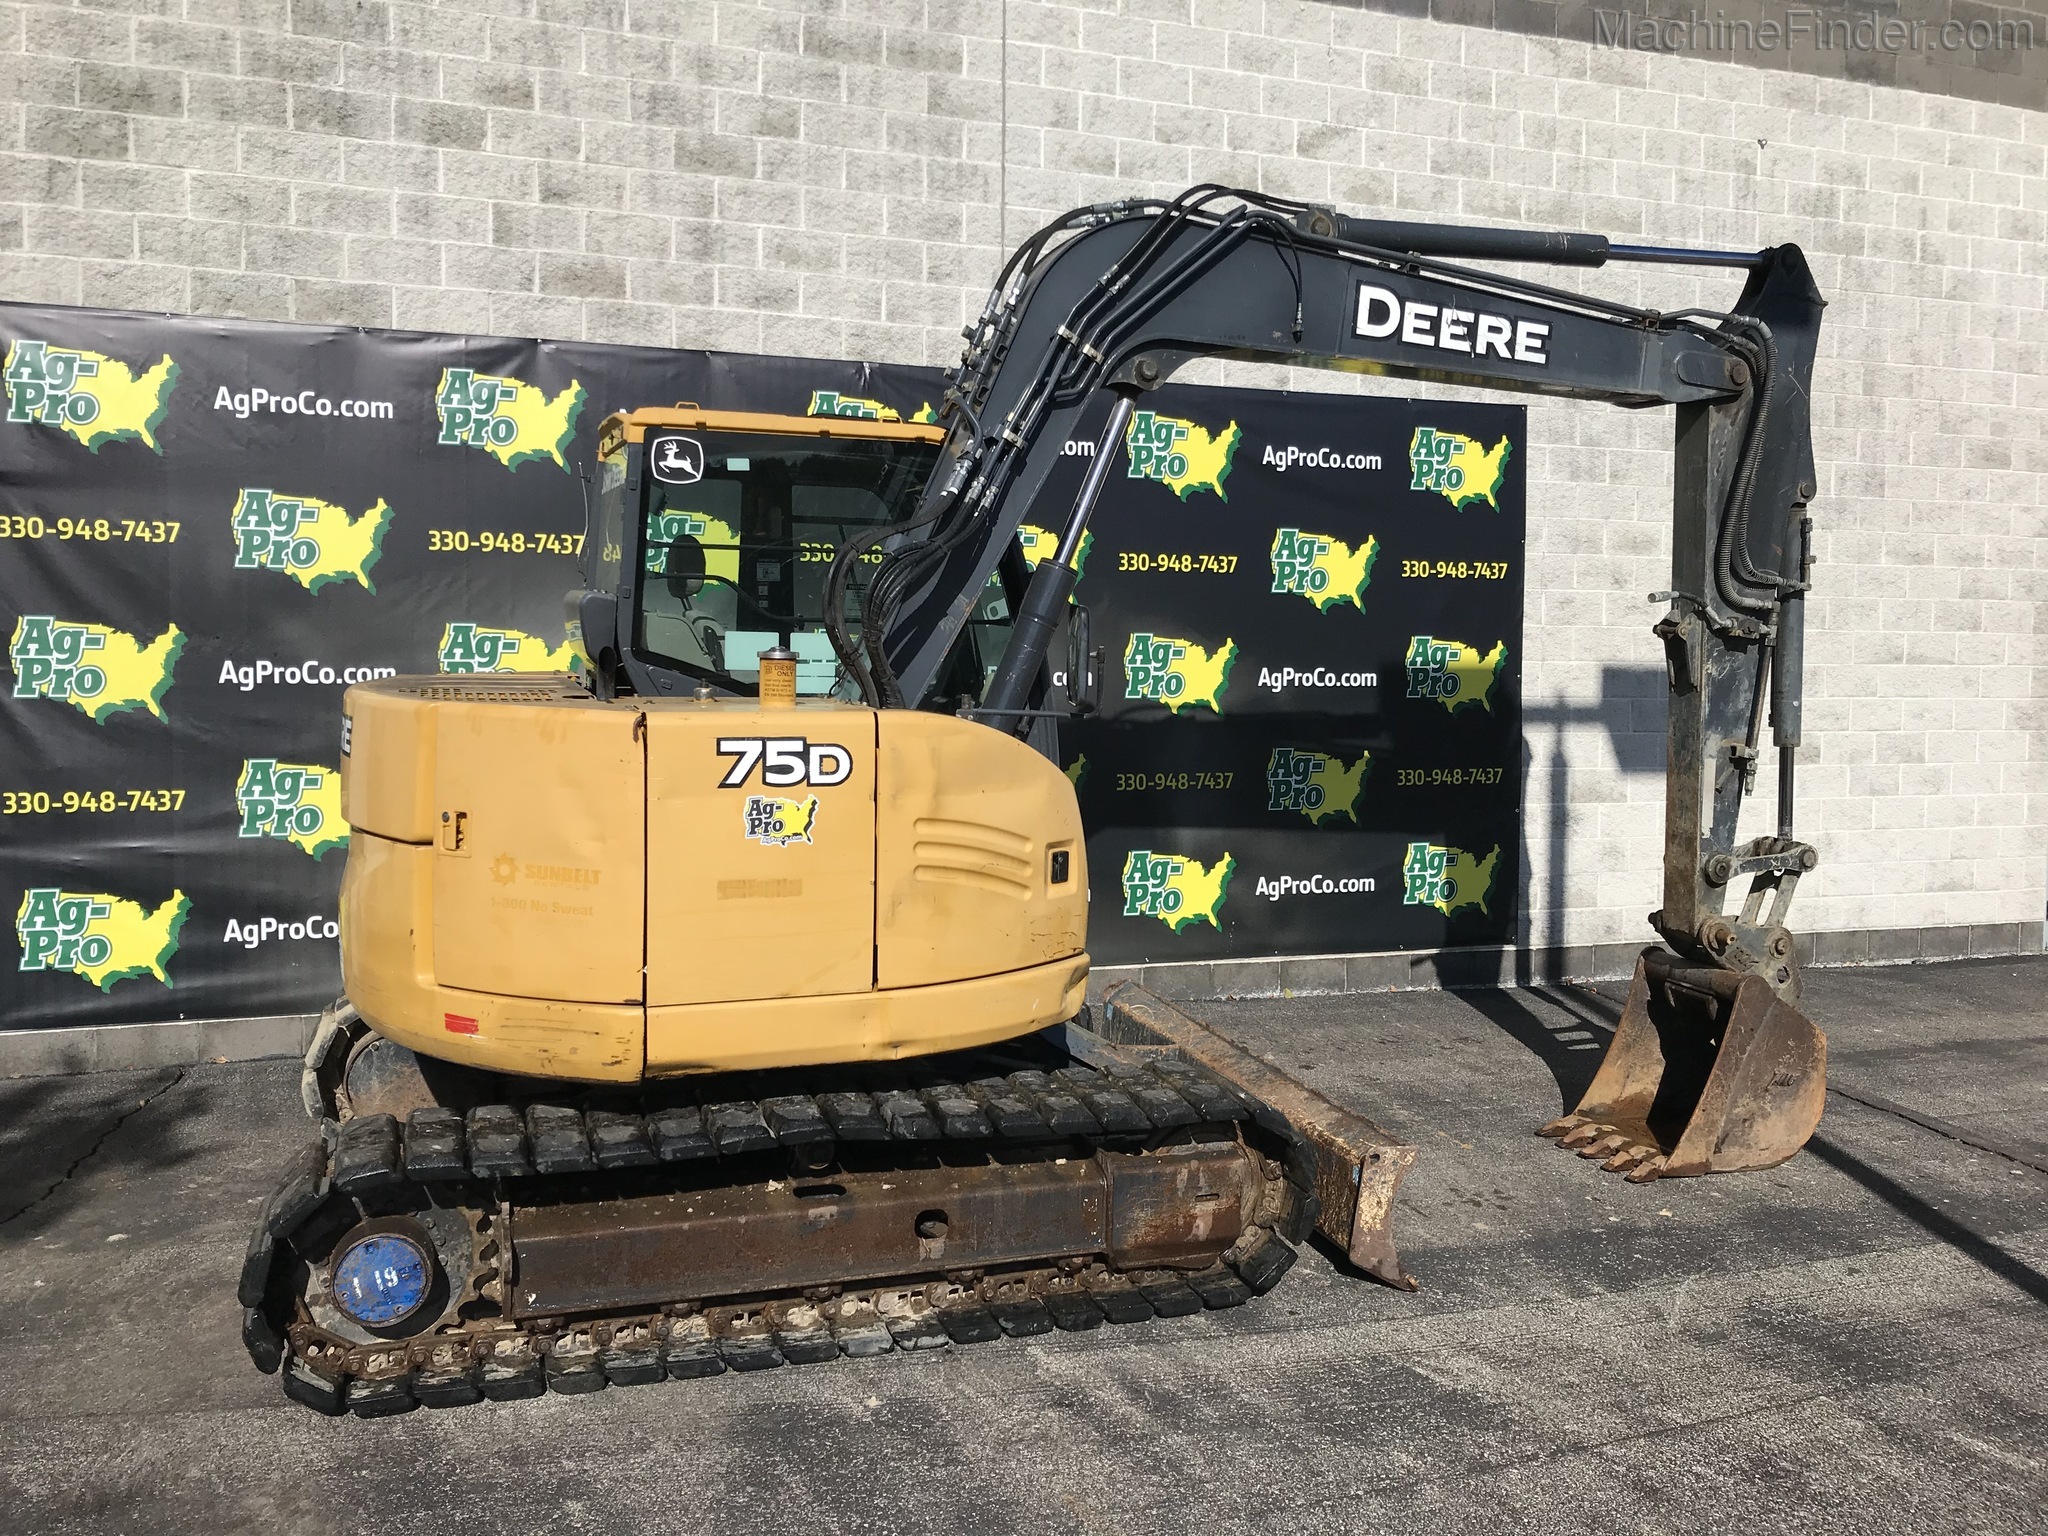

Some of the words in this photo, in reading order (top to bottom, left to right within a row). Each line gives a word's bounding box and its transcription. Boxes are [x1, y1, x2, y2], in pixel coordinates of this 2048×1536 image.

[1356, 284, 1549, 364] DEERE
[7, 341, 98, 389] Ag-
[7, 382, 100, 424] Pro
[213, 386, 394, 418] AgProCo.com
[439, 368, 518, 414] Ag-
[438, 406, 518, 445] Pro
[1128, 411, 1188, 447] Ag-
[1127, 445, 1188, 479] Pro
[1262, 445, 1382, 471] AgProCo.com
[1413, 427, 1465, 466] Ag-
[1411, 459, 1465, 490] Pro
[0, 515, 181, 543] 330-948-7437
[234, 489, 319, 537] Ag-
[234, 528, 320, 568] Pro
[1118, 553, 1238, 574] 330-948-7437
[1273, 528, 1330, 565] Ag-
[1271, 561, 1329, 593] Pro
[1401, 561, 1508, 579] 330-948-7437
[12, 616, 105, 664] Ag-
[440, 623, 520, 670] Ag-
[1127, 633, 1185, 671] Ag-
[1408, 636, 1461, 672] Ag-
[13, 657, 106, 698] Pro
[218, 660, 397, 692] AgProCo.com
[1125, 666, 1185, 699] Pro
[1258, 668, 1377, 692] AgProCo.com
[1406, 668, 1460, 698] Pro
[716, 736, 853, 789] 75D
[1269, 748, 1325, 784] Ag-
[1397, 768, 1503, 786] 330-948-7437
[241, 759, 322, 805] Ag-
[1116, 773, 1234, 791] 330-948-7437
[1268, 779, 1325, 810] Pro
[3, 790, 186, 814] 330-948-7437
[238, 798, 323, 837] Pro
[747, 798, 783, 820] Ag-
[747, 817, 785, 836] Pro
[524, 864, 602, 885] SUNBELT
[1125, 851, 1183, 888] Ag-
[1406, 843, 1458, 878] Ag-
[1123, 884, 1183, 916] Pro
[1255, 875, 1376, 901] AgProCo.com
[1403, 874, 1458, 905] Pro
[21, 888, 110, 935] Ag-
[530, 900, 549, 912] No
[552, 901, 594, 917] Sweat
[18, 927, 112, 971] Pro
[223, 915, 339, 949] AgProCo
